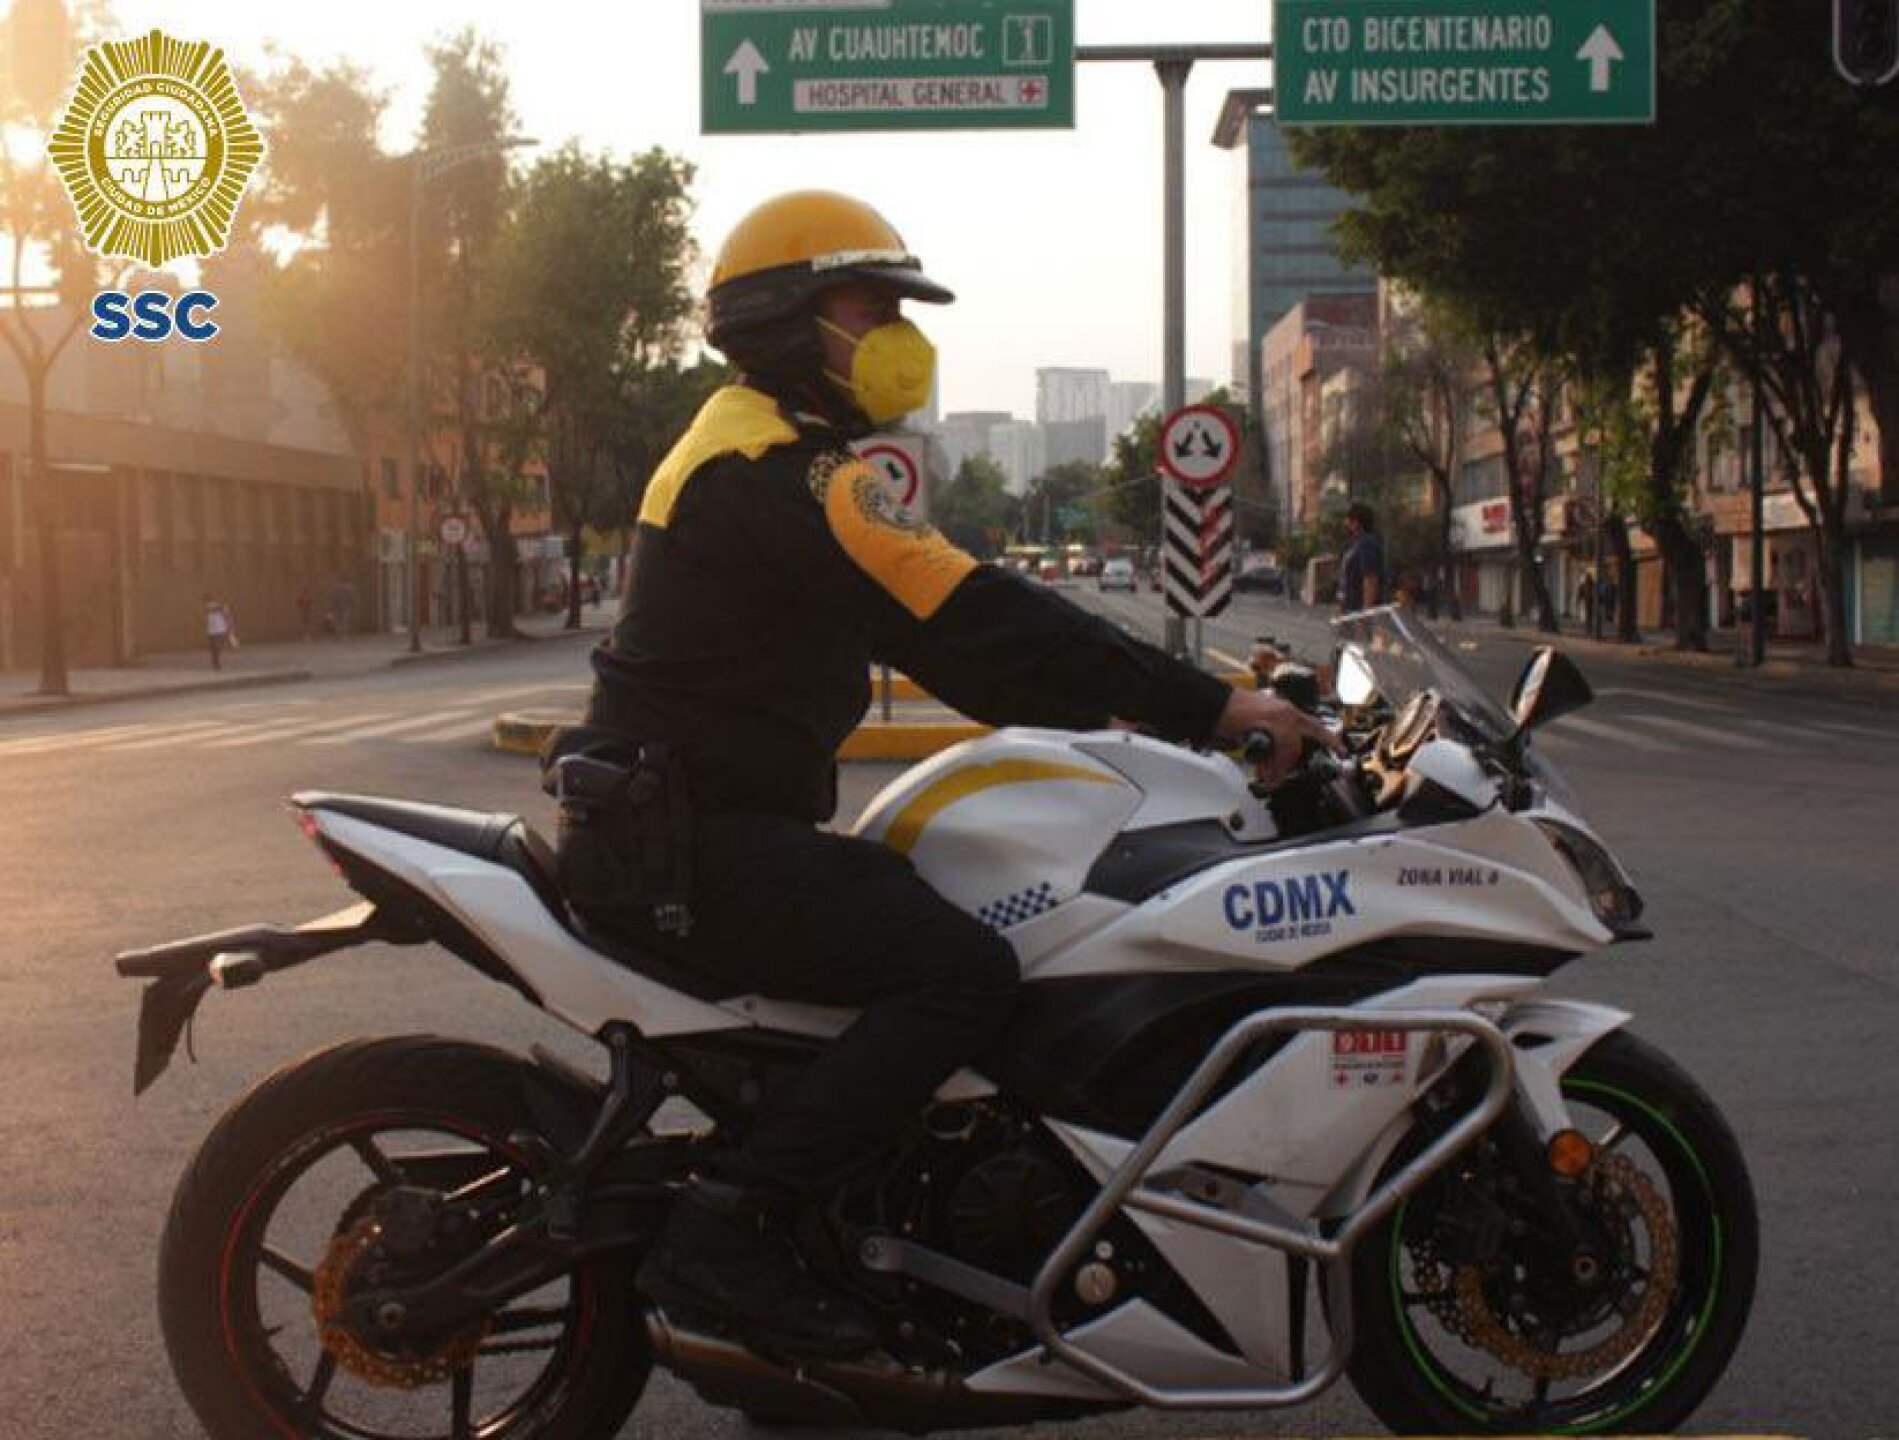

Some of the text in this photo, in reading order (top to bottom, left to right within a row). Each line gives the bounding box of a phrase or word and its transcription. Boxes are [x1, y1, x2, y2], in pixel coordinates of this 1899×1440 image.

[788, 24, 985, 62] AV CUAUHTEMOC
[1303, 15, 1551, 53] CTO BICENTENARIO
[808, 81, 1006, 107] HOSPITAL GENERAL
[1303, 67, 1550, 104] AV INSURGENTES
[1397, 867, 1442, 887] ZONA
[1448, 867, 1482, 887] VIAL
[1222, 869, 1356, 930] CDMX
